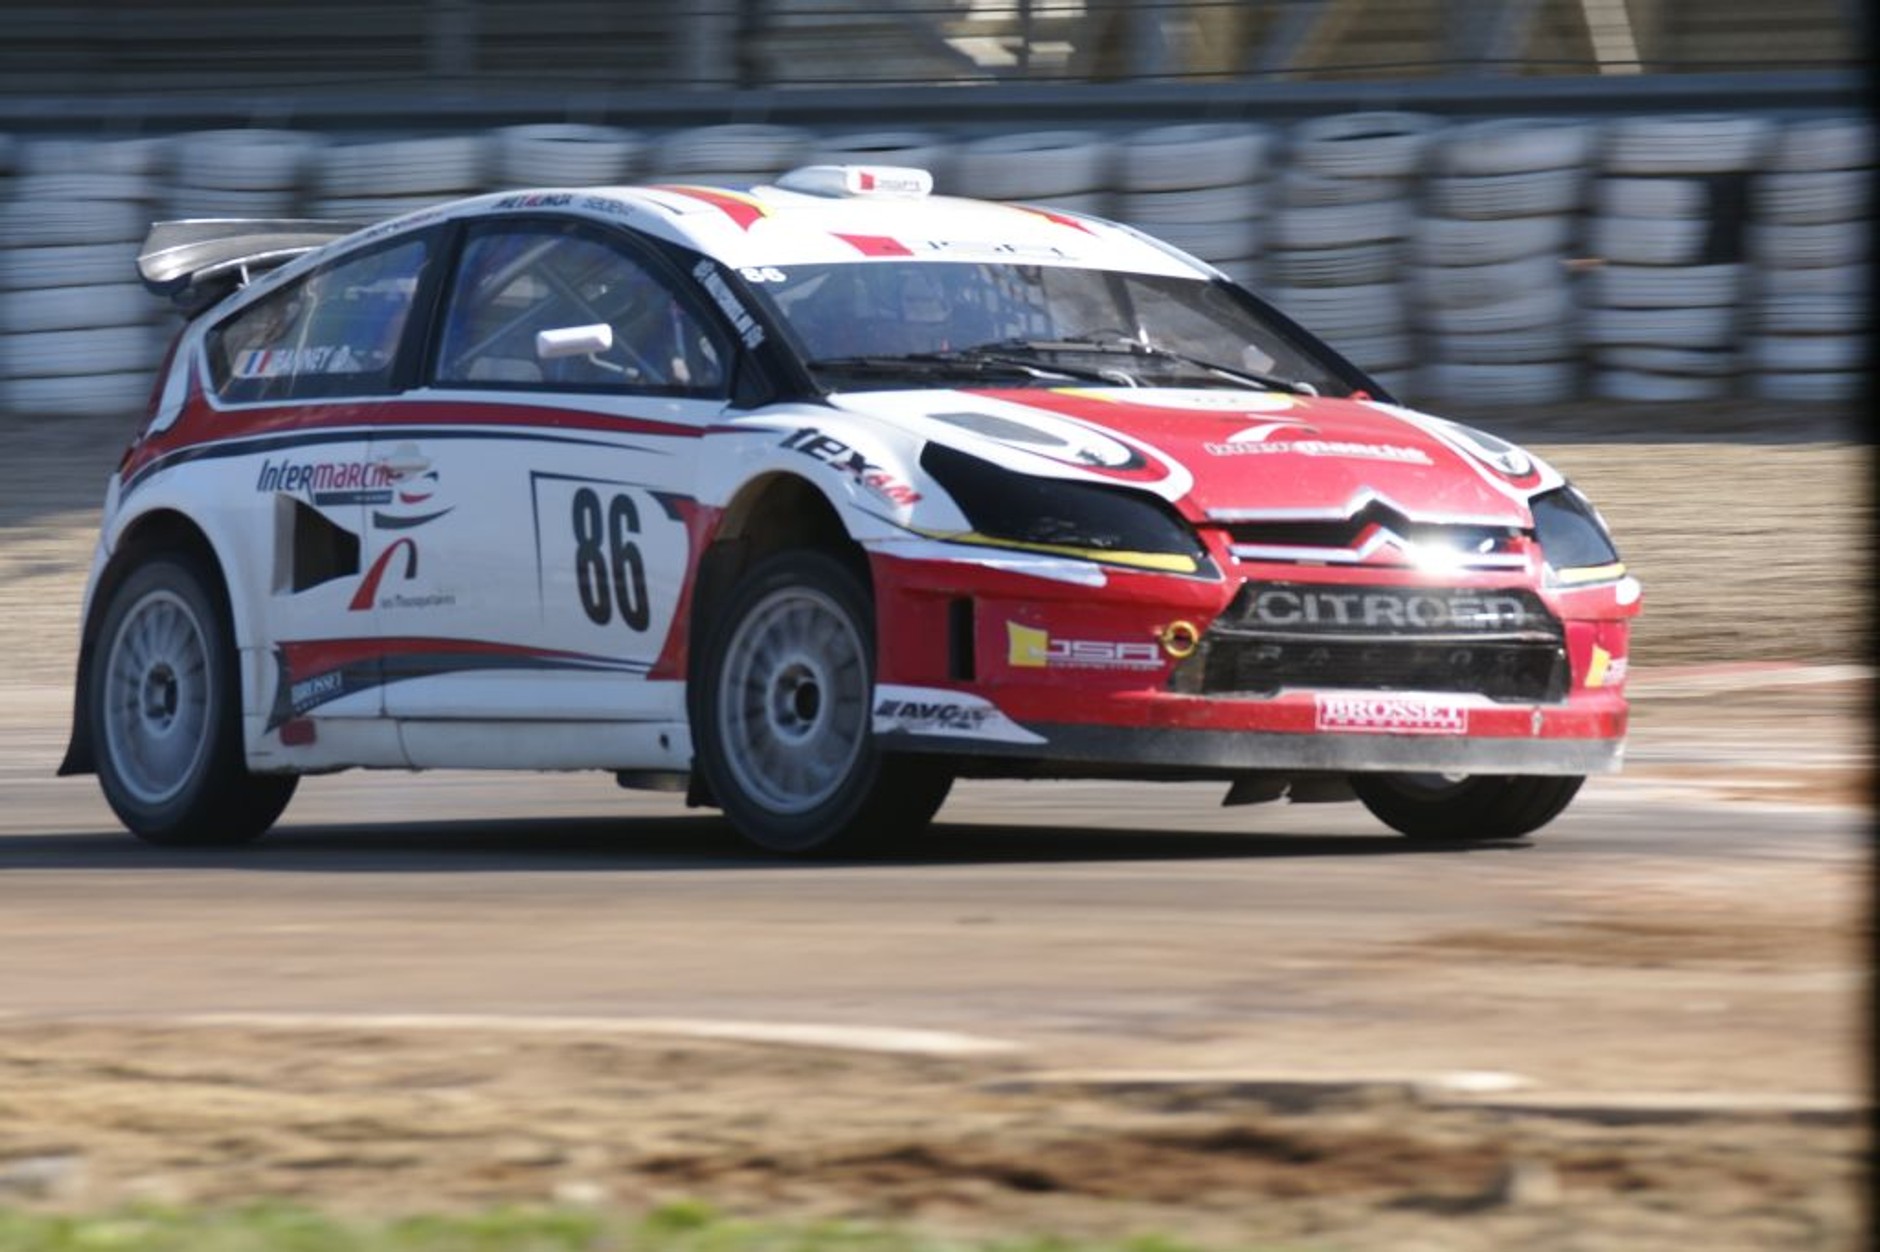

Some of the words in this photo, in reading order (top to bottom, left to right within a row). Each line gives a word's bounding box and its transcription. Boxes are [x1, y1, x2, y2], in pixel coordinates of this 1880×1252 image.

[739, 268, 787, 282] 86
[571, 487, 649, 632] 86
[1036, 640, 1164, 665] JSA
[1324, 699, 1462, 721] BROSSET
